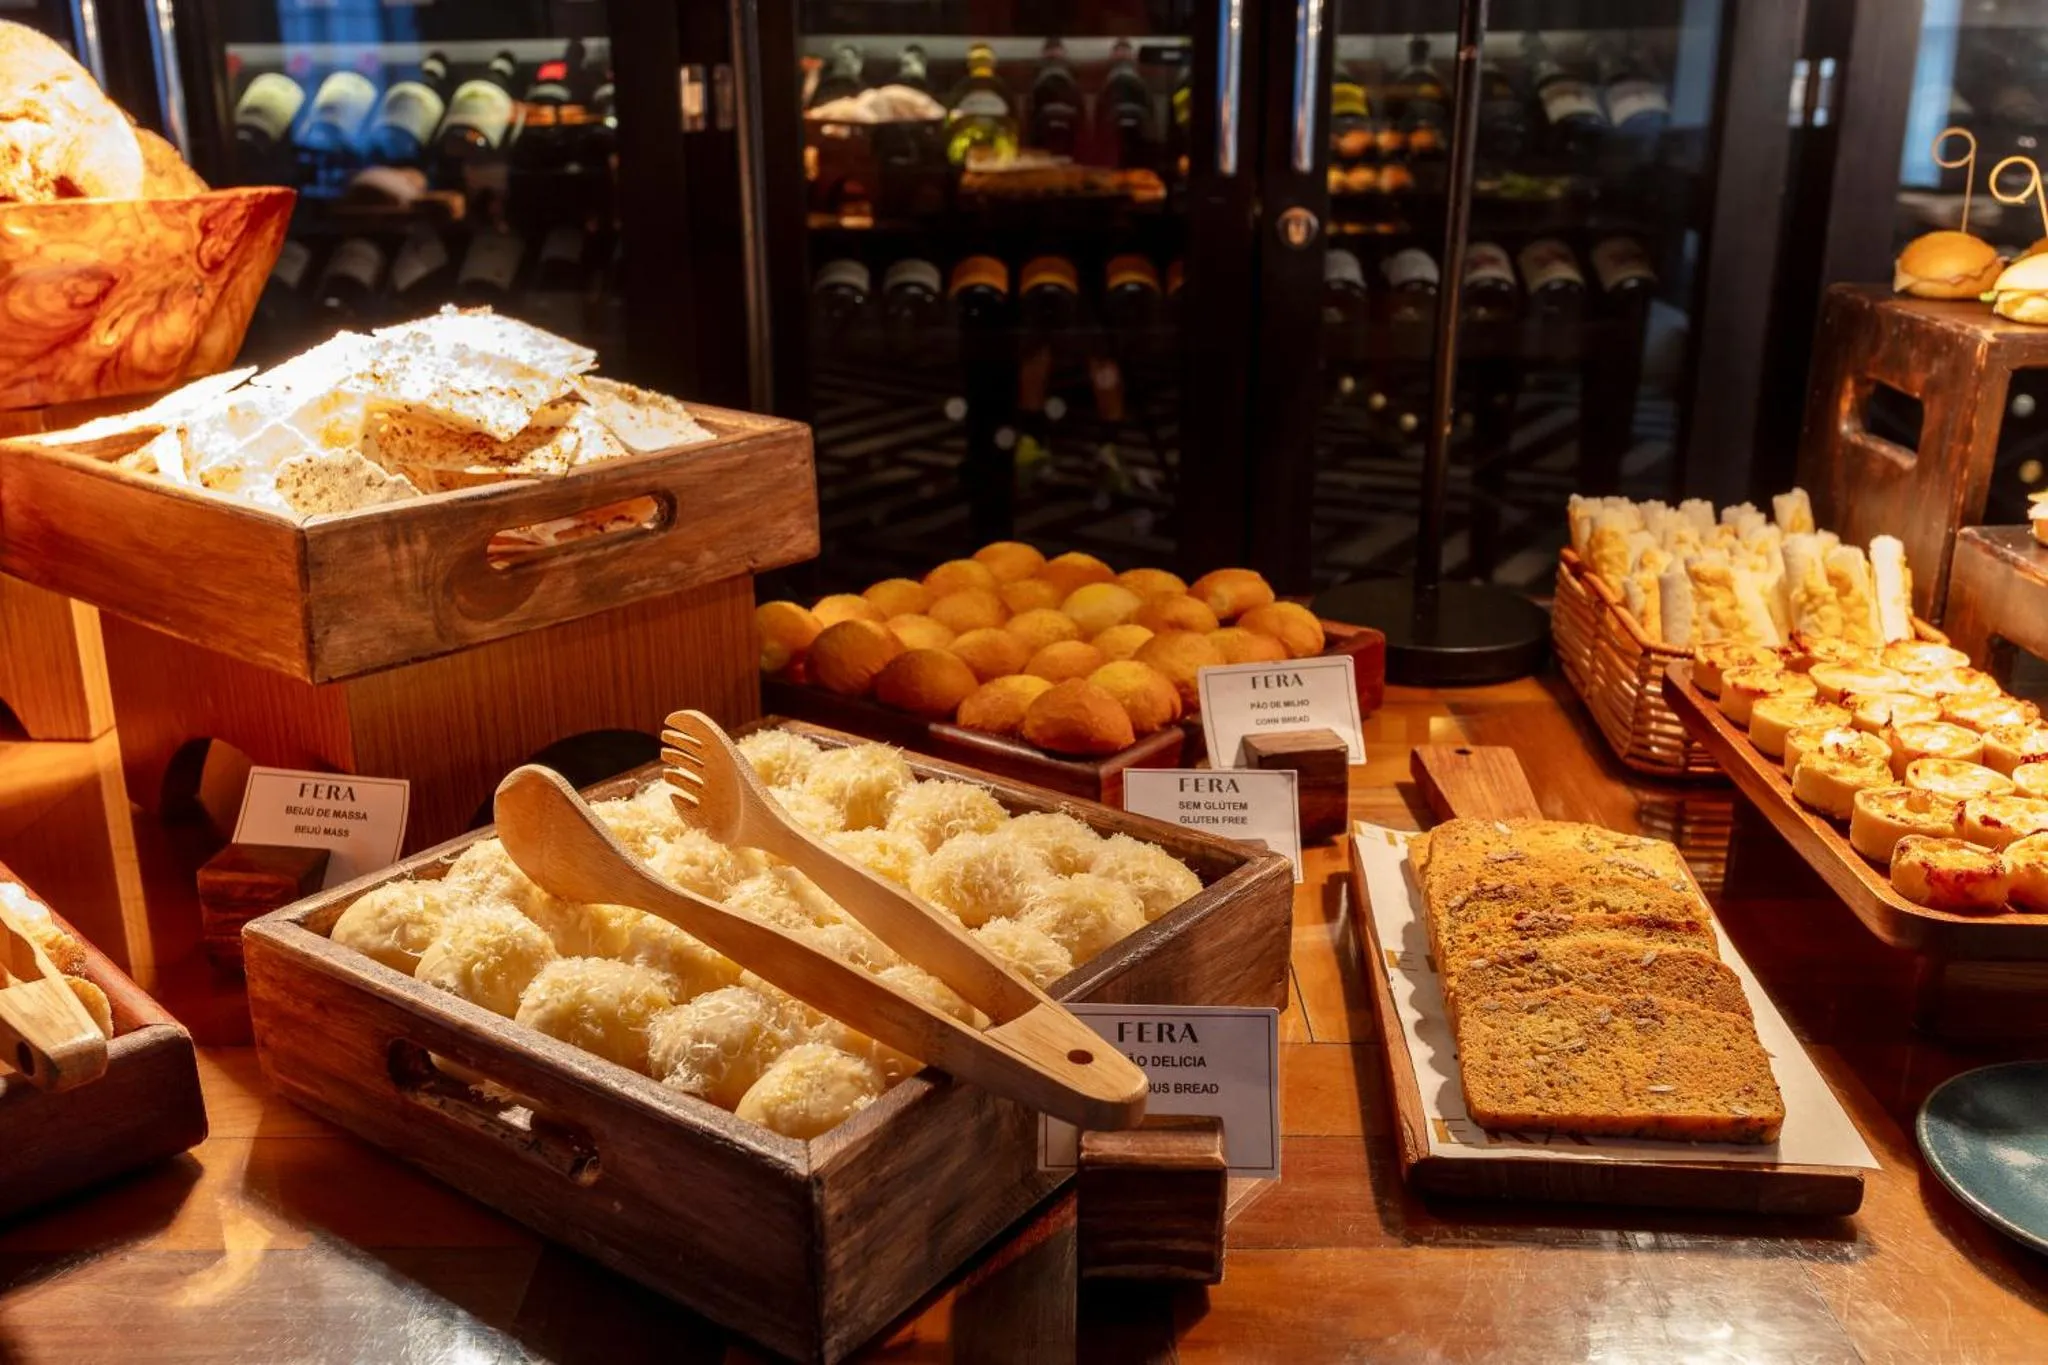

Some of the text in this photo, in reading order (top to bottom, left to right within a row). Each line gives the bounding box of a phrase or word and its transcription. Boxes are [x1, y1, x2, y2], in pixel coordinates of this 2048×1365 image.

[1251, 673, 1304, 689] FERA
[299, 783, 356, 802] FERA
[1179, 778, 1240, 793] FERA
[1179, 801, 1201, 810] SEM
[316, 808, 331, 818] DE
[332, 809, 368, 821] MASSA
[1180, 815, 1248, 825] GLUTEN FREE
[323, 826, 350, 838] MASS
[1117, 1021, 1199, 1044] FERA
[1128, 1053, 1207, 1068] ÃO DELICIA
[1174, 1083, 1219, 1095] BREAD
